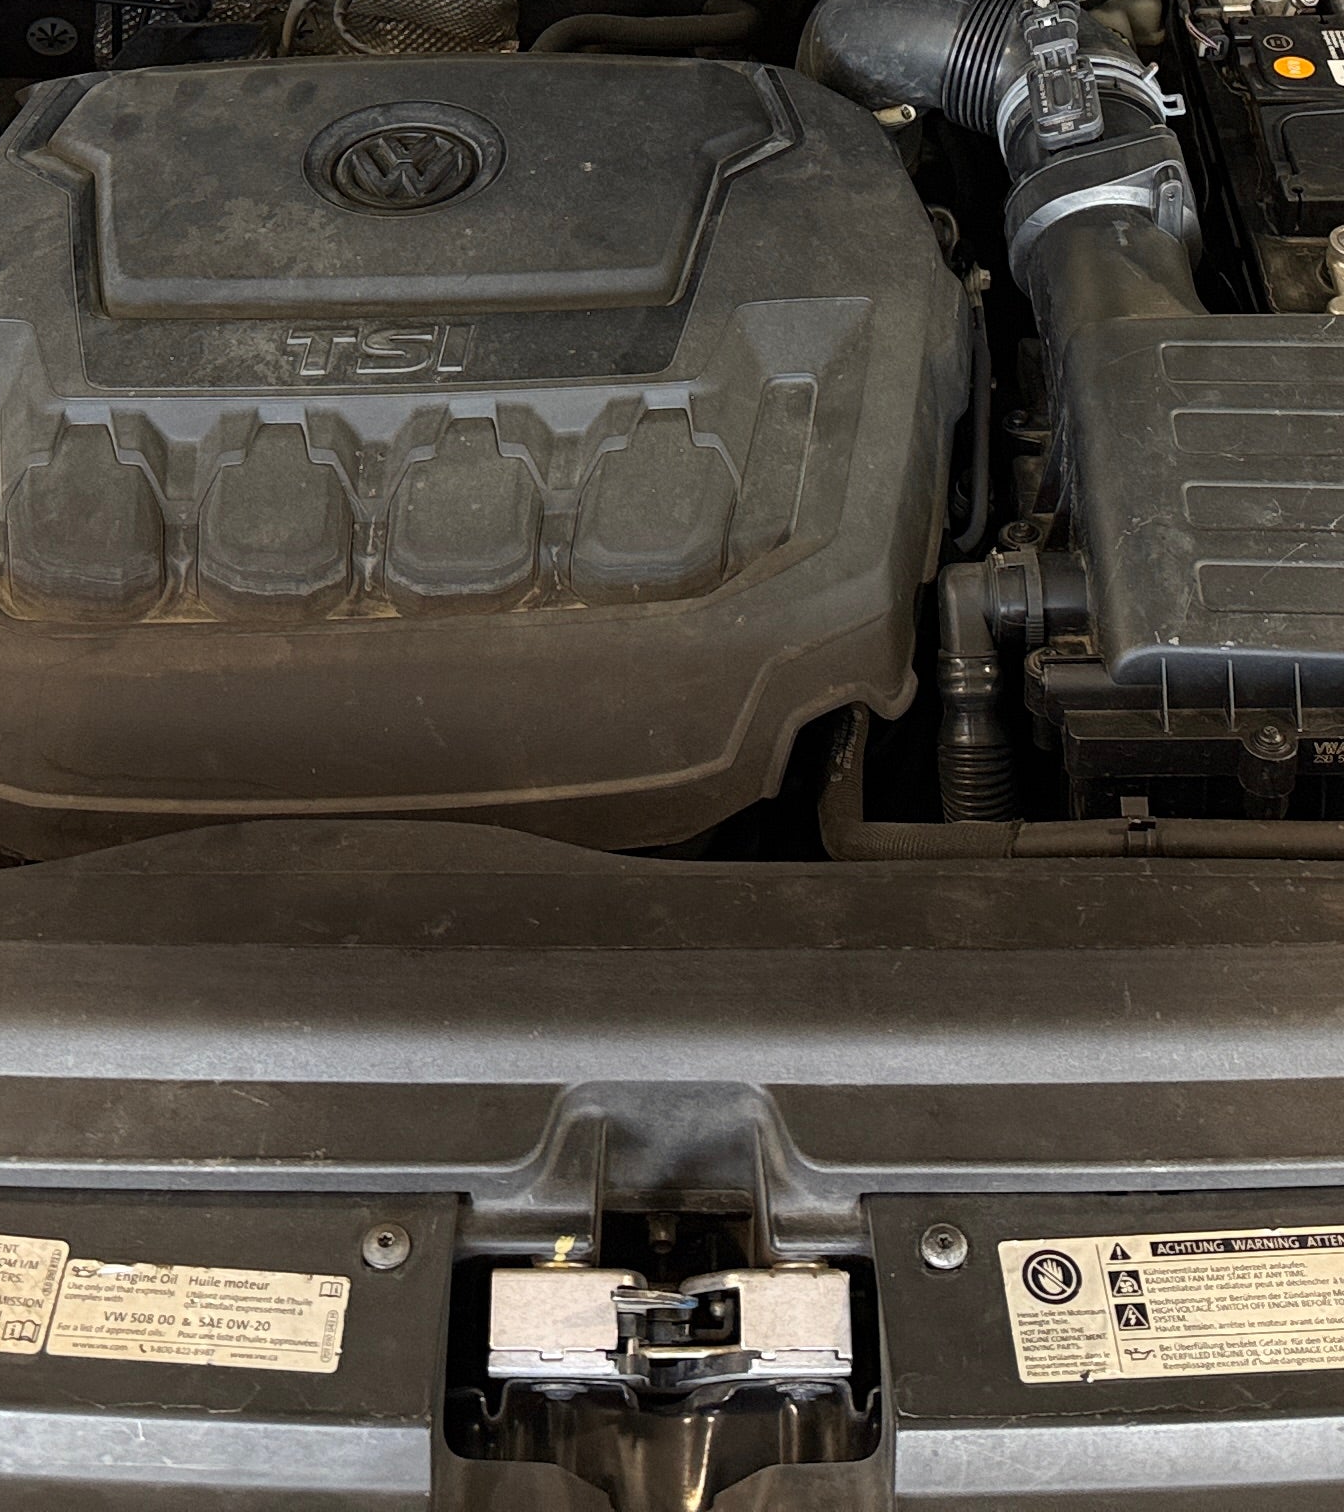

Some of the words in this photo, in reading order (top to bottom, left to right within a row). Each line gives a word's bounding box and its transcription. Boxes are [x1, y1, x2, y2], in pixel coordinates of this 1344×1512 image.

[286, 325, 477, 377] TSI
[1157, 1240, 1224, 1254] ACHTUNG
[1231, 1236, 1299, 1250] WARNING
[115, 1272, 158, 1285] Engine
[159, 1273, 178, 1284] Oil
[188, 1276, 221, 1287] Huile
[224, 1280, 270, 1290] moteur
[1144, 1275, 1186, 1284] RADIATOR
[1227, 1272, 1251, 1280] START
[1151, 1306, 1174, 1314] HIGH
[1249, 1301, 1266, 1309] OFF
[103, 1311, 127, 1322] VW
[130, 1312, 154, 1324] 508
[157, 1314, 176, 1325] 00
[181, 1317, 192, 1326] &
[199, 1316, 223, 1328] SAE
[226, 1318, 271, 1331] 0W-20
[1160, 1351, 1211, 1361] OVERFILLED
[1211, 1349, 1244, 1358] ENGINE
[1262, 1348, 1282, 1356] CAN
